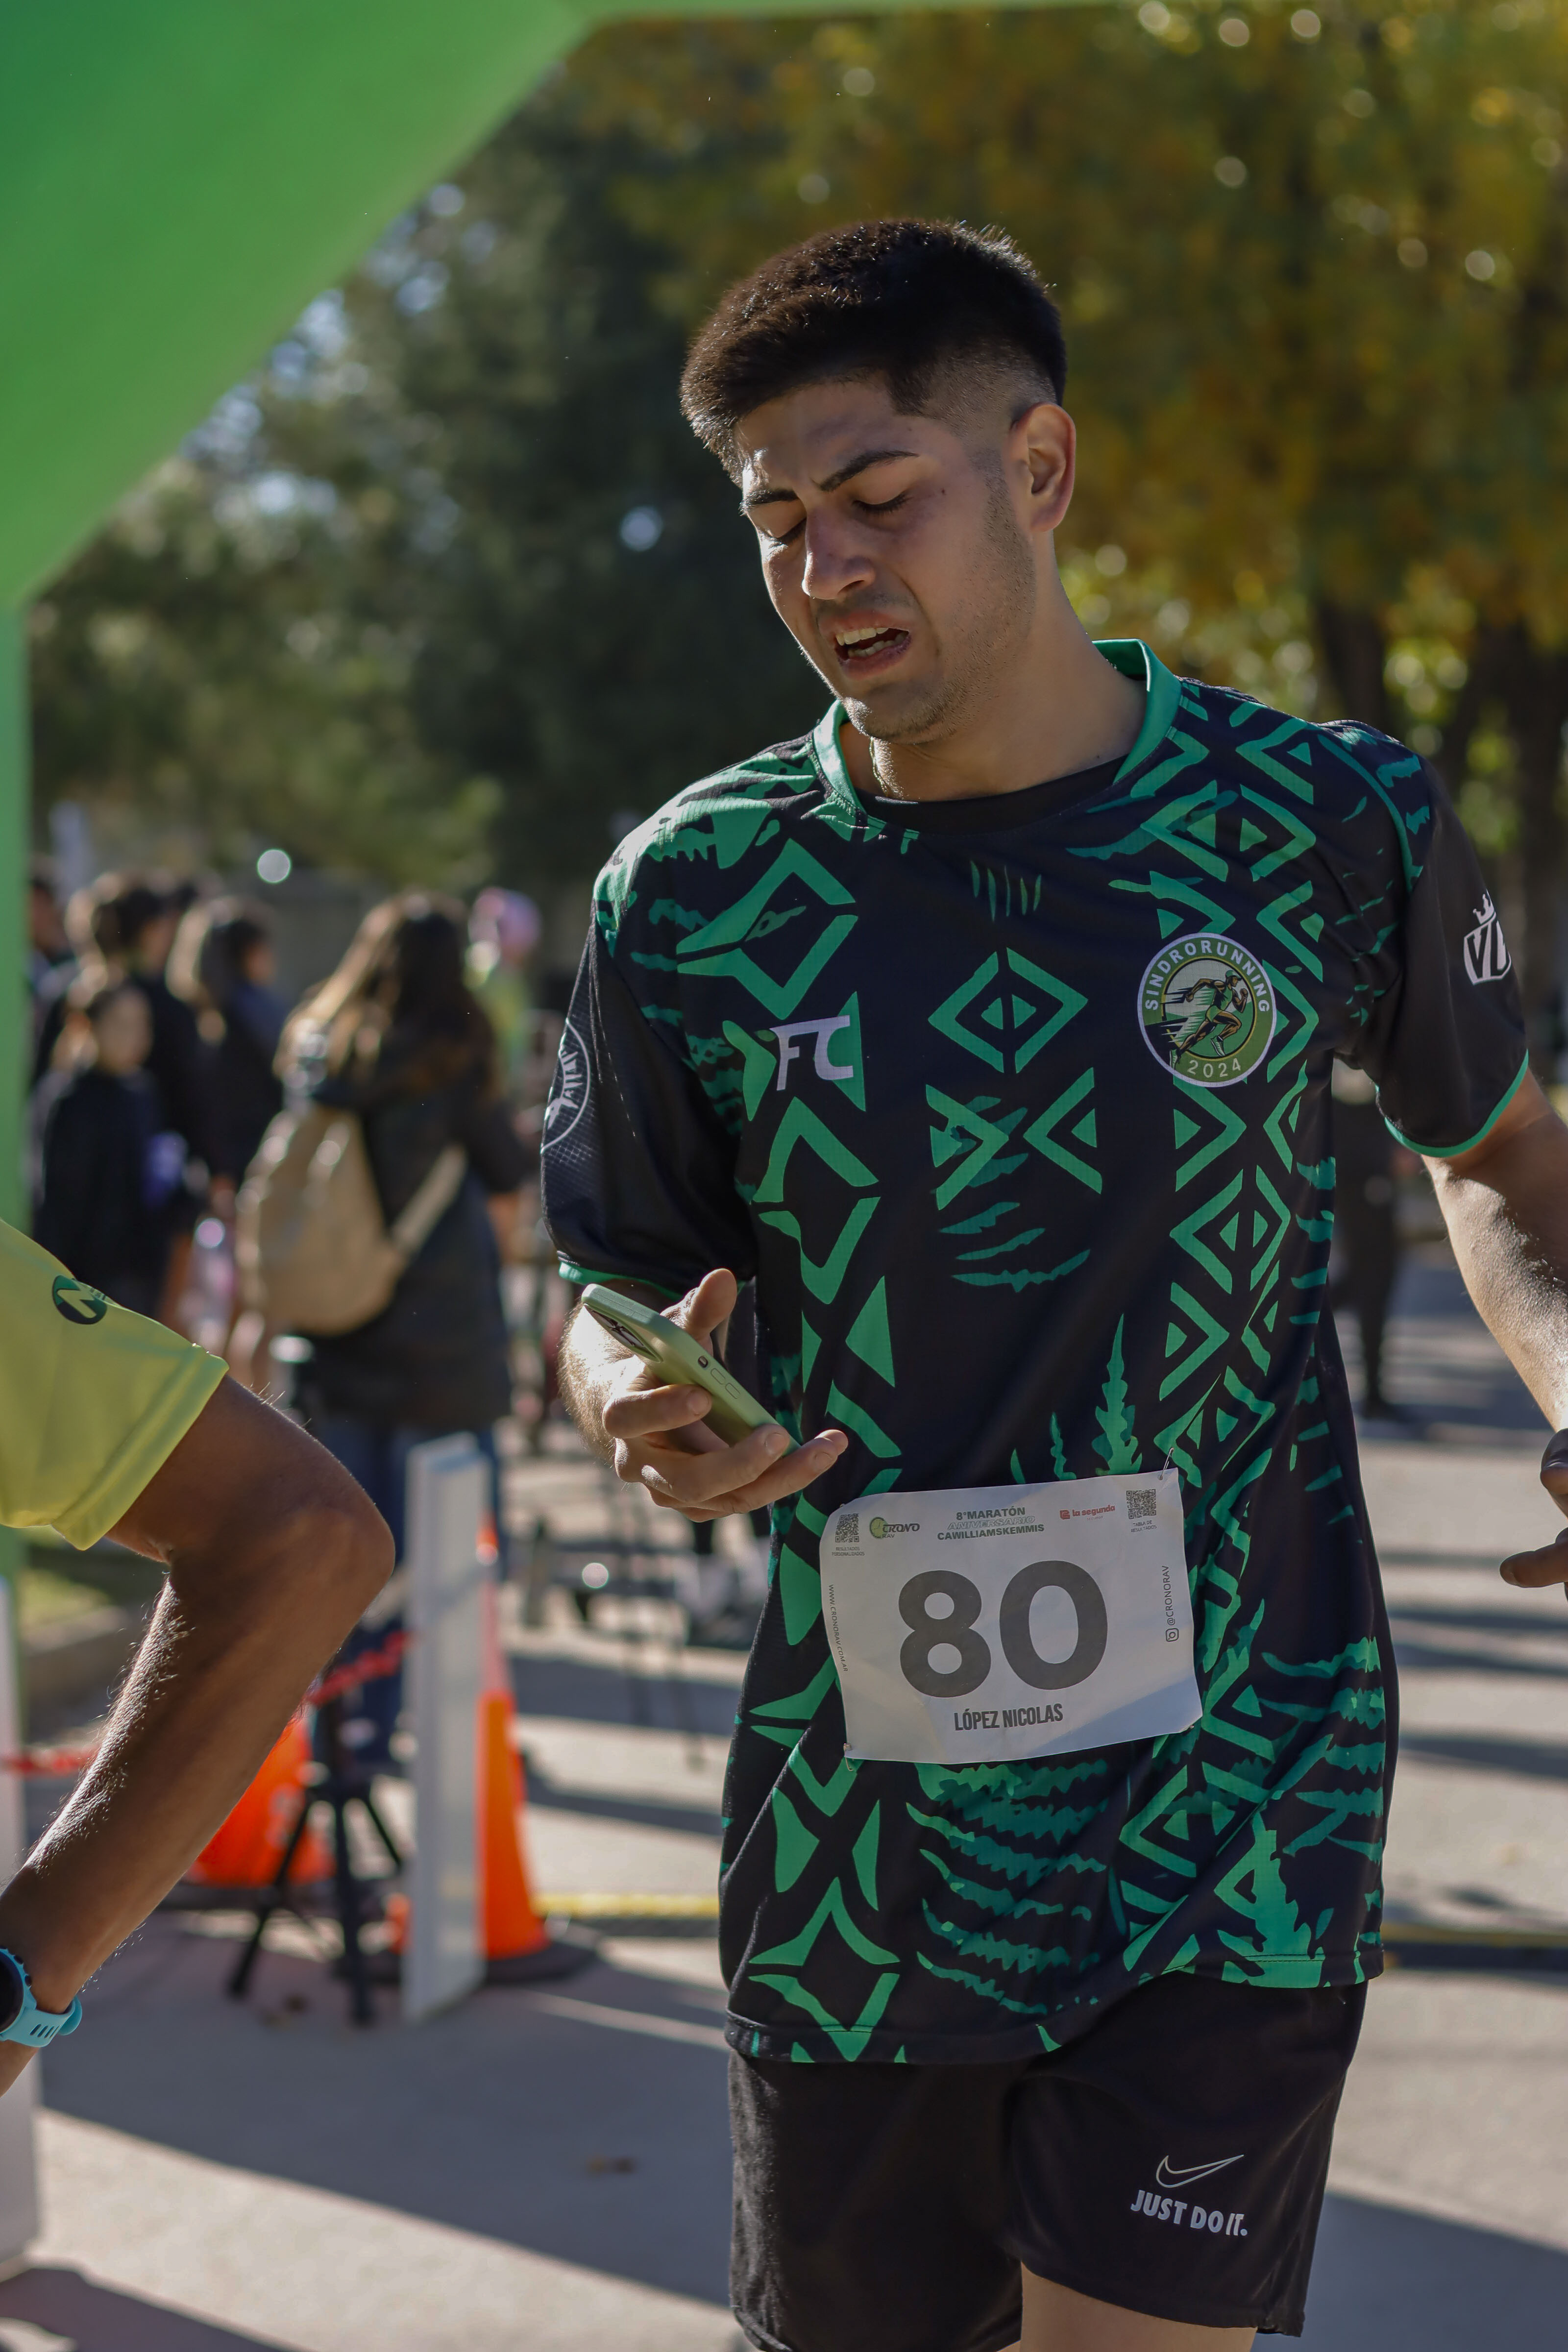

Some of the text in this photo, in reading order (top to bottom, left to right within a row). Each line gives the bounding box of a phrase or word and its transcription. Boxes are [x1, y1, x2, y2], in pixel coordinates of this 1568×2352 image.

[1145, 940, 1270, 1012] SINDRORUNNING
[1187, 1058, 1241, 1078] 2024
[947, 1516, 1036, 1530] ANIVERSARIO
[1081, 1504, 1116, 1516] segunda
[882, 1523, 920, 1532] CRONO
[937, 1524, 1045, 1540] CAWILLIAMSKEMMIS
[1162, 1566, 1176, 1626] @CRONORAV
[829, 1584, 848, 1672] WWW.CRONORAV.COM.AR
[898, 1560, 1108, 1698] 80
[954, 1703, 1064, 1731] LÓPEZ NICOLAS
[1130, 2190, 1248, 2236] JUST DO IT.
